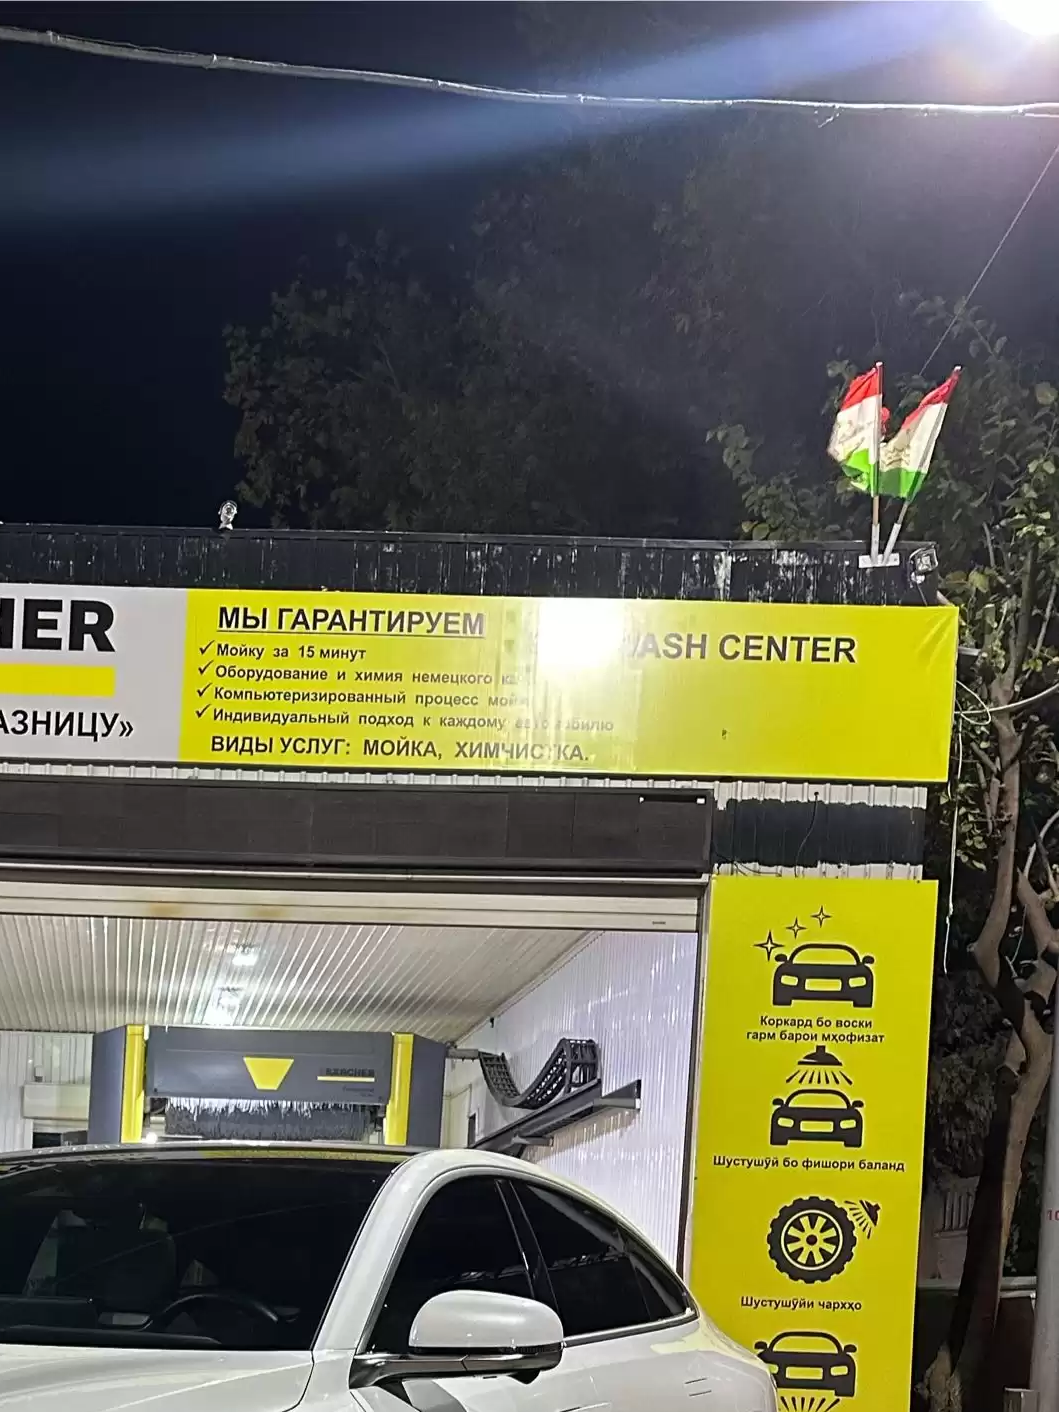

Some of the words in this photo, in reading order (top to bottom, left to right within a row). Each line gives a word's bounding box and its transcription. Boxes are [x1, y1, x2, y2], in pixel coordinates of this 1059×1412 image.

[218, 606, 268, 630] МЫ
[277, 607, 485, 635] ГАРАНТИРУЕМ
[217, 643, 265, 660] Мойку
[273, 647, 289, 658] за
[299, 645, 315, 658] 15
[320, 648, 367, 663] минут
[618, 631, 708, 660] ASH
[719, 633, 856, 664] CENTER
[215, 664, 328, 682] Оборудование
[337, 670, 346, 681] и
[355, 670, 403, 682] химия
[412, 671, 493, 686] немецкого
[214, 686, 406, 705] Компьютеризированный
[415, 694, 479, 707] процесс
[488, 692, 530, 707] мой
[213, 707, 350, 726] Индивидуальный
[358, 714, 414, 727] подход
[423, 716, 431, 726] к
[439, 716, 507, 731] каждому
[211, 735, 273, 756] ВИДЫ
[280, 737, 351, 755] УСЛУГ:
[363, 736, 443, 760] МОЙКА,
[760, 1015, 813, 1029] Коркард
[816, 1016, 832, 1028] бо
[835, 1019, 872, 1029] воски
[746, 1030, 776, 1042] гарм
[780, 1030, 818, 1043] барои
[782, 1157, 798, 1168] бо
[802, 1157, 855, 1171] фишори
[858, 1159, 905, 1172] баланд
